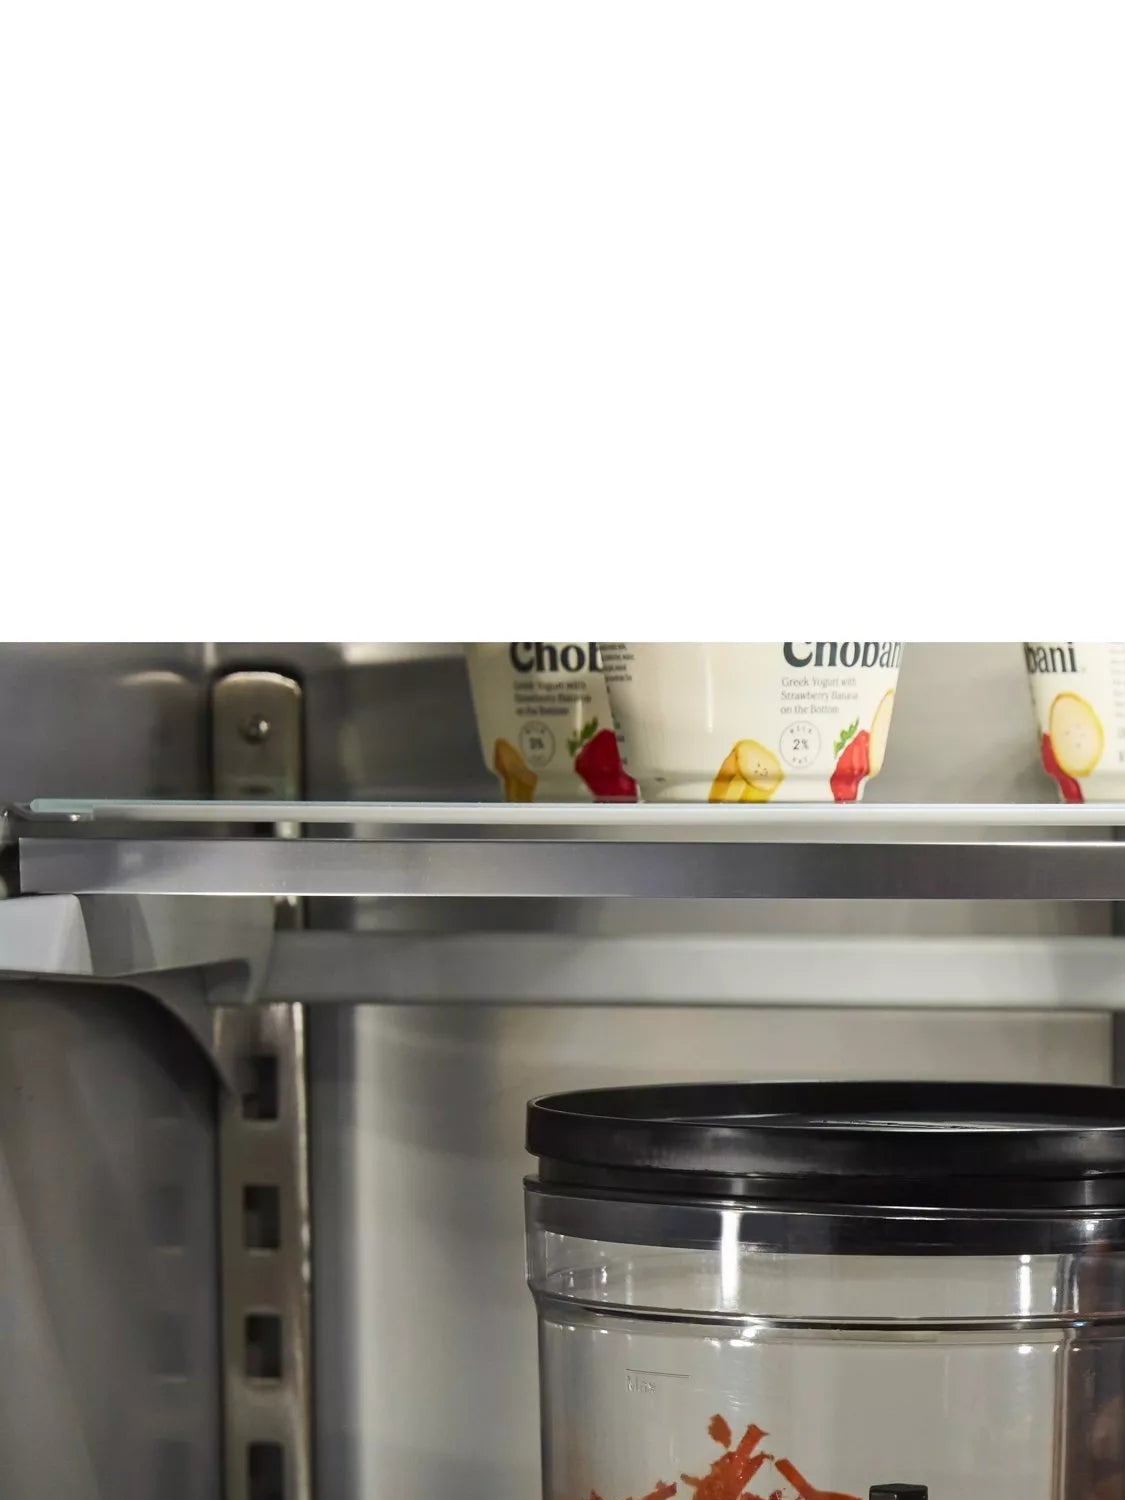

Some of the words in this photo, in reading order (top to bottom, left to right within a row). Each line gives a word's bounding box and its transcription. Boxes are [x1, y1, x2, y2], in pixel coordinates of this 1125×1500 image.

[781, 677, 809, 687] Greek
[812, 676, 840, 688] Yogurt
[841, 677, 857, 687] with
[781, 690, 829, 702] Strawberry
[780, 706, 792, 714] on
[794, 704, 809, 714] the
[792, 738, 809, 751] 2%
